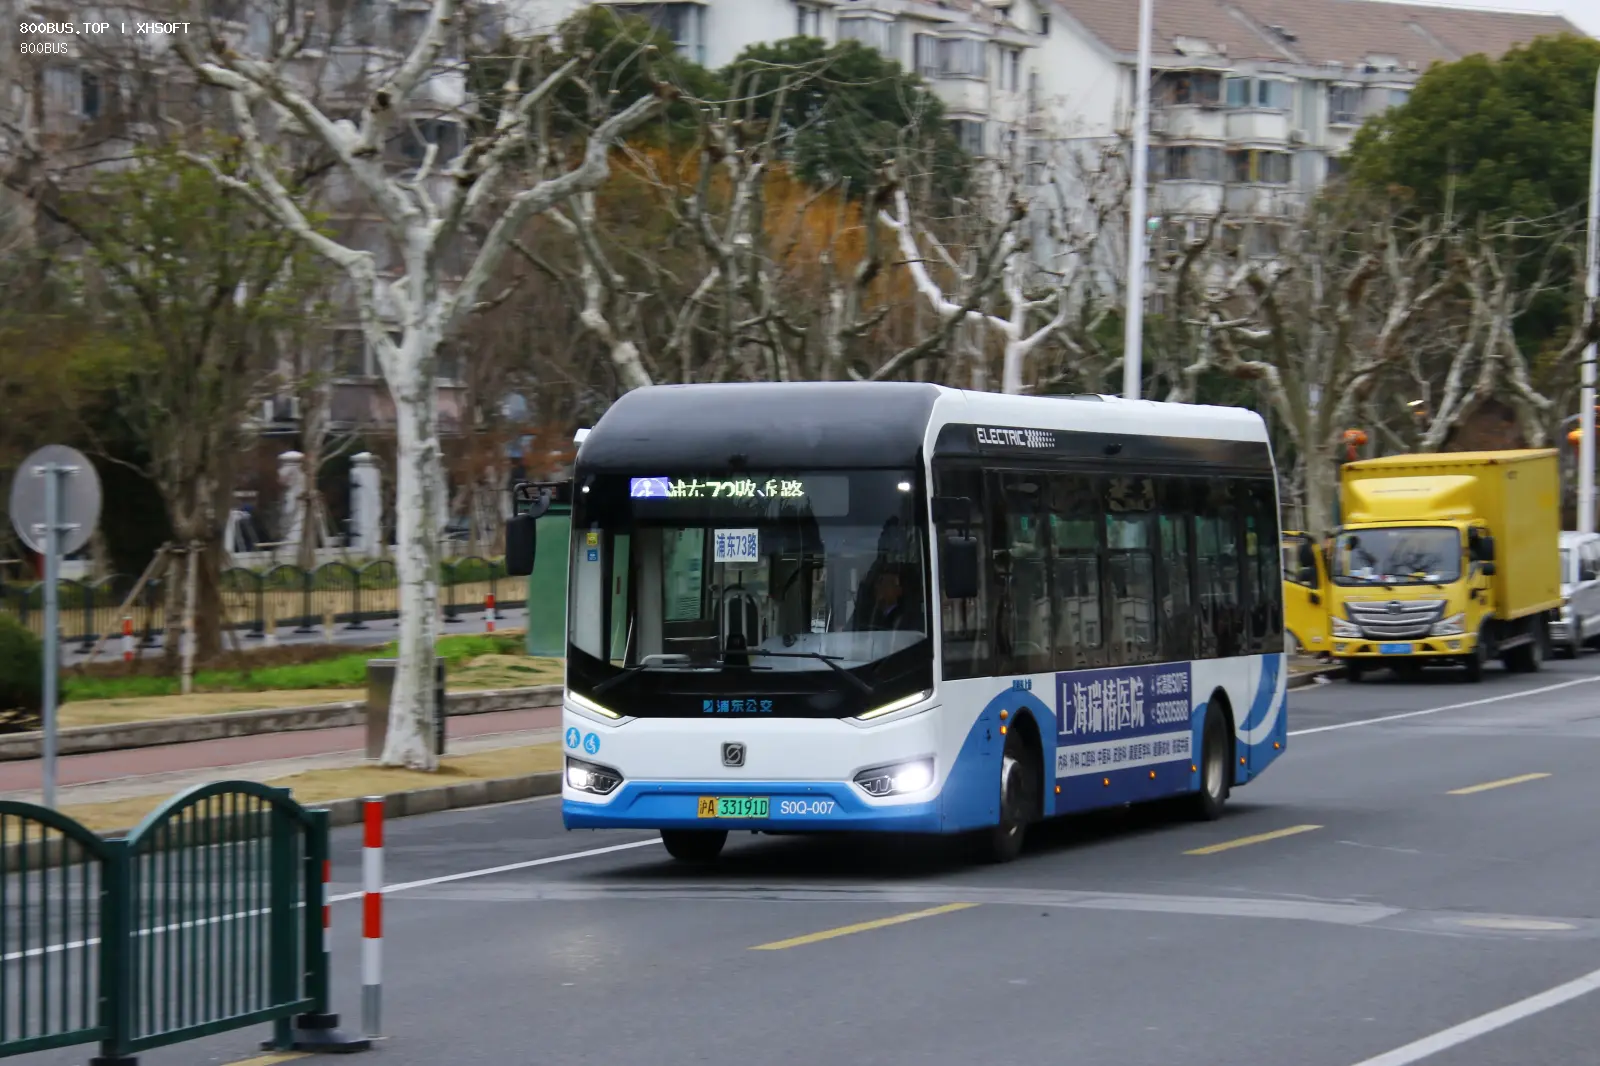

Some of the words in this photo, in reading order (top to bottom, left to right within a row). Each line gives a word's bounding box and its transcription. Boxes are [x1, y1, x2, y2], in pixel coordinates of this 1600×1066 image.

[976, 427, 1026, 446] ELECTRIC
[716, 533, 757, 559] 浦东73路
[716, 699, 773, 713] 浦东公交
[1058, 676, 1145, 736] 上海瑞椿医院
